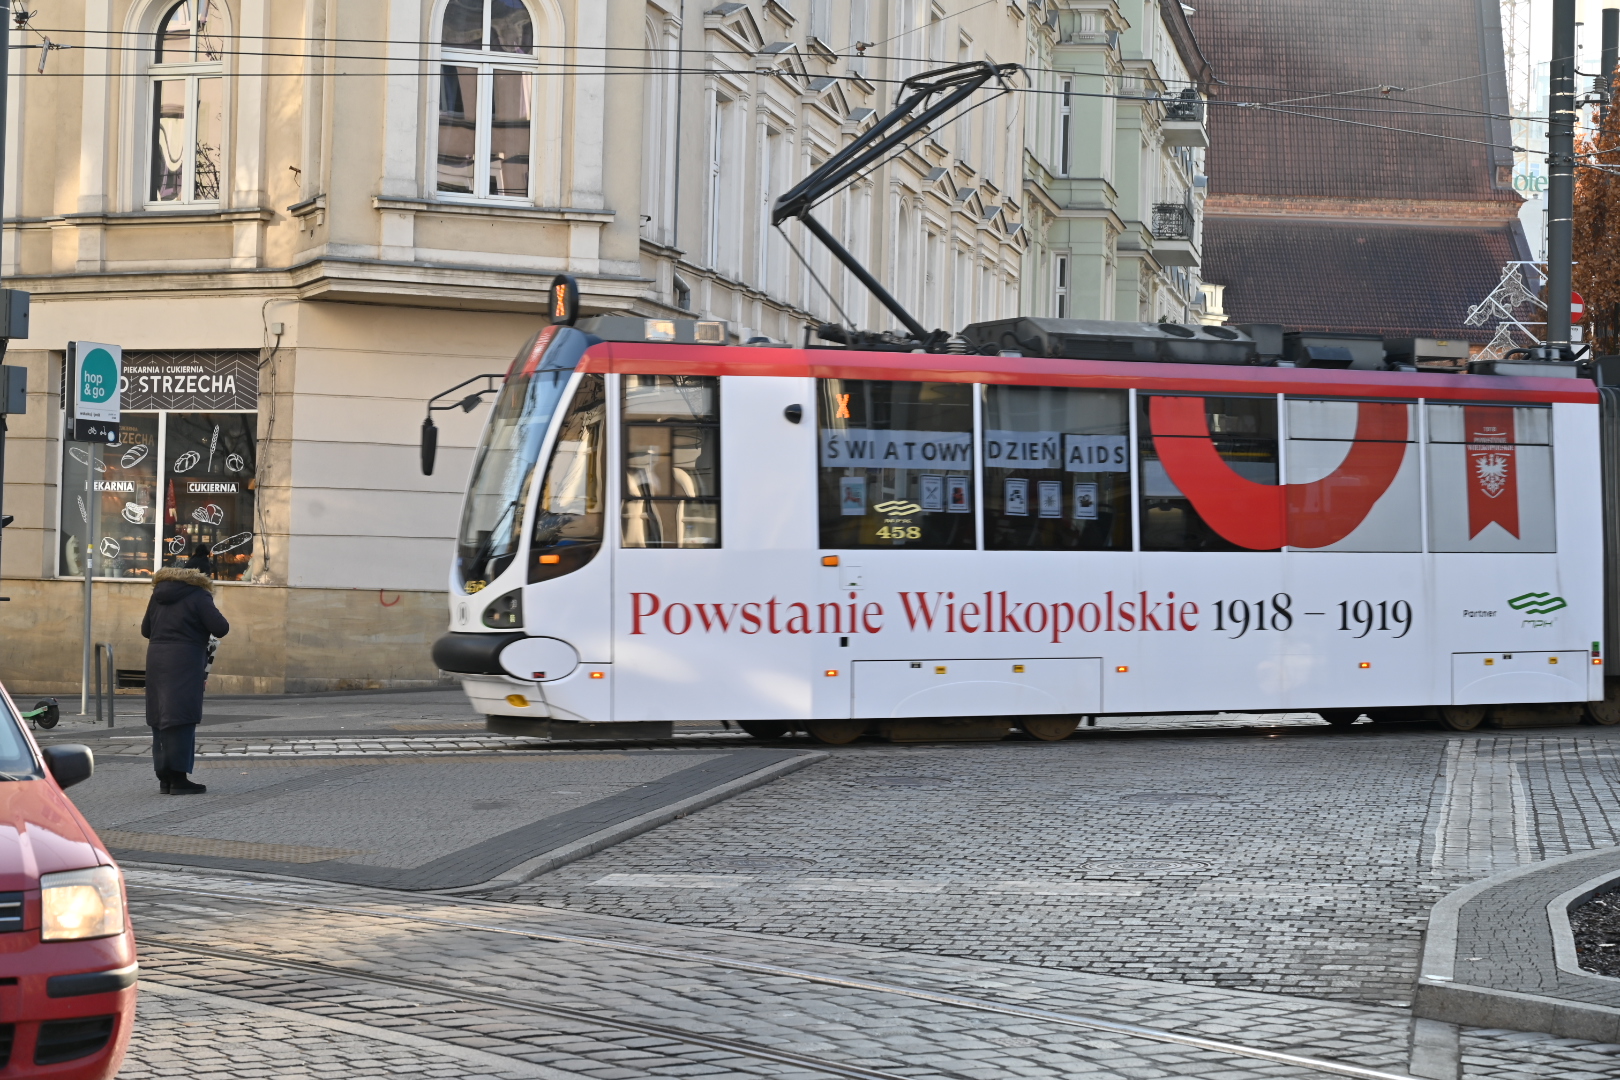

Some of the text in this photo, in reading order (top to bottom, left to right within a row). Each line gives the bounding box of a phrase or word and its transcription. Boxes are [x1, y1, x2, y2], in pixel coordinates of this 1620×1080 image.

[1514, 171, 1548, 192] ote
[123, 366, 160, 374] PIEKARNIA
[166, 366, 204, 374] CUKIERNIA
[84, 371, 103, 386] hop
[84, 387, 105, 399] & go
[835, 393, 851, 418] X
[827, 434, 1125, 465] ŚWIATOWY DZIEŃ AIDS
[85, 481, 133, 491] EKARNIA
[189, 483, 237, 492] CUKIERNIA
[875, 526, 922, 539] 458
[627, 590, 885, 636] Powstanie
[898, 590, 1199, 644] Wielkopolskie
[1211, 592, 1293, 639] 1918
[1336, 599, 1413, 639] 1919
[1463, 609, 1497, 618] Partner
